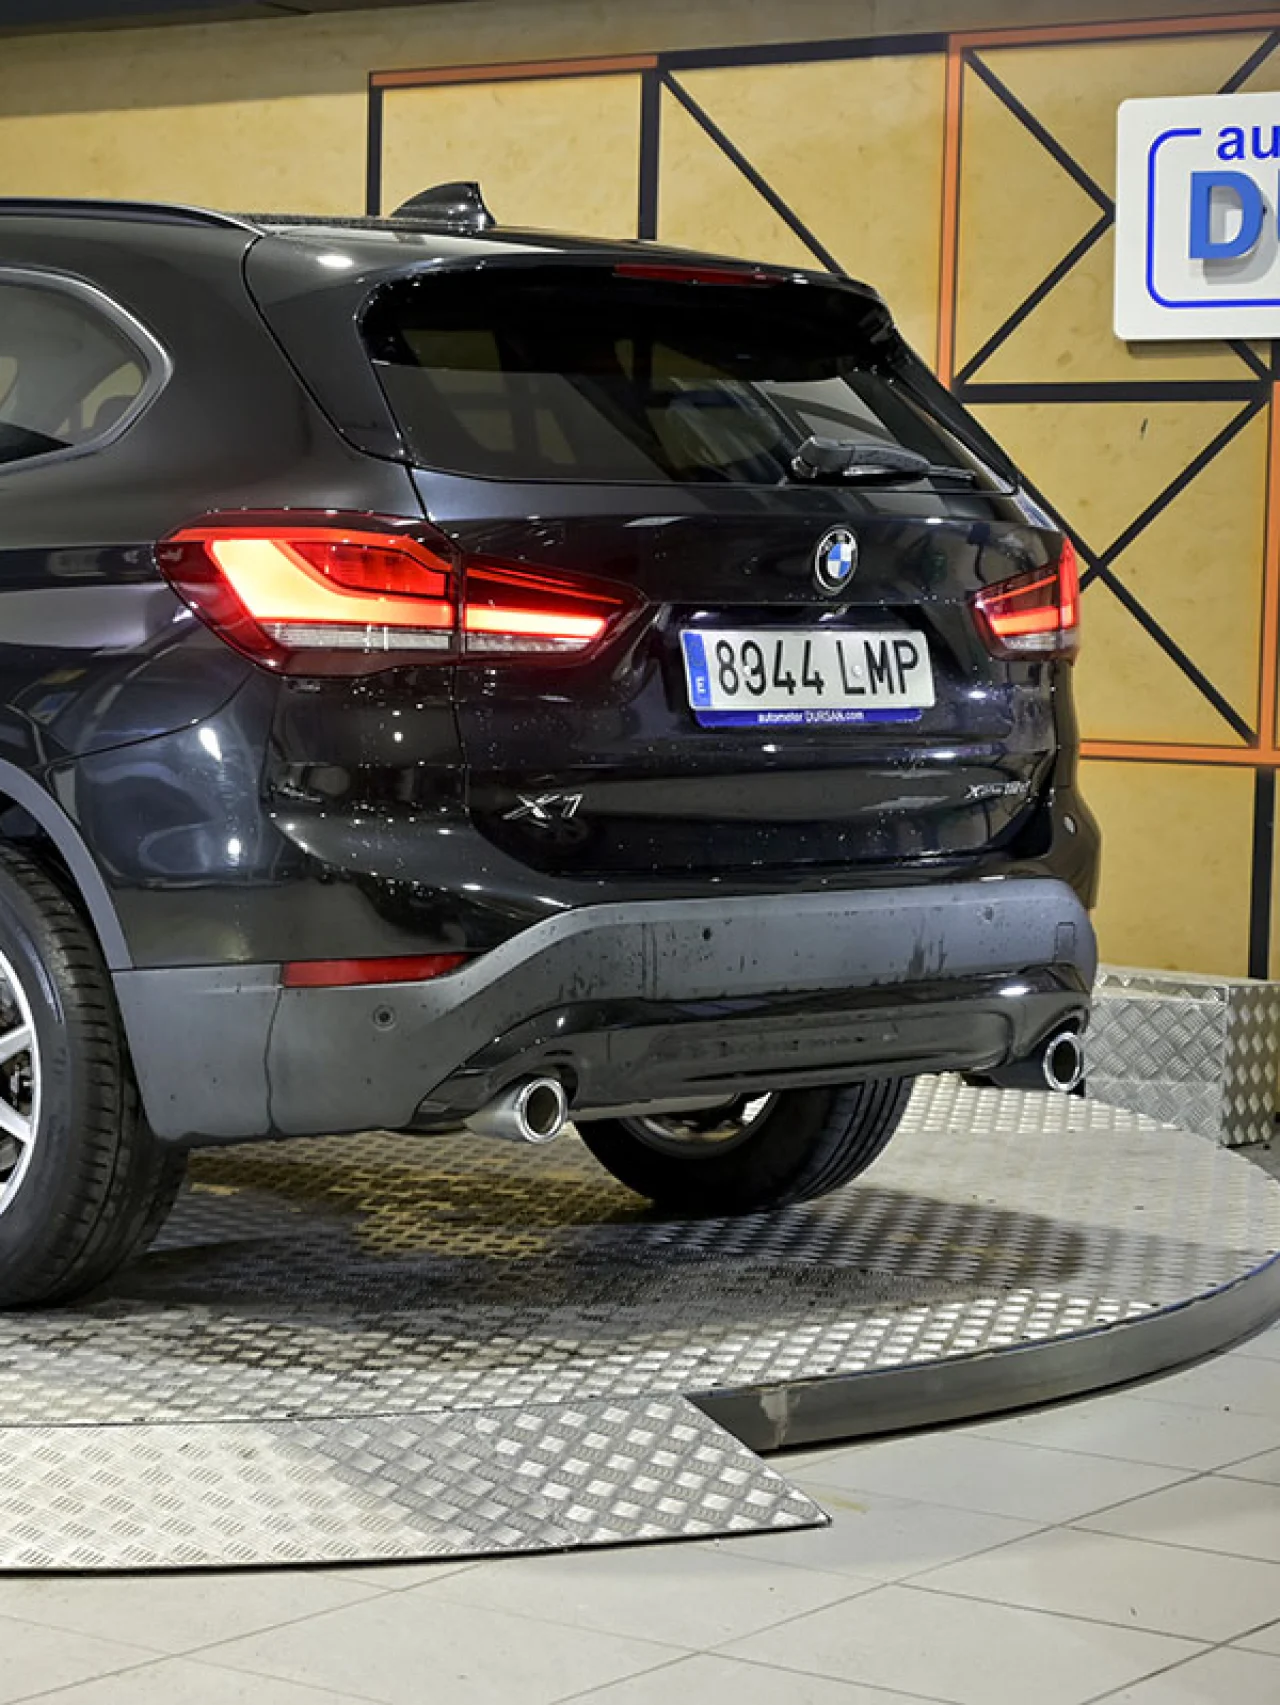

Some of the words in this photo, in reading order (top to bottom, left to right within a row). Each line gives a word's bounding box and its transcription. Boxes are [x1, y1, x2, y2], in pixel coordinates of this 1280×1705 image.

[1187, 169, 1280, 260] D
[696, 676, 706, 694] E
[715, 639, 825, 696] 8944
[835, 639, 919, 695] LMP
